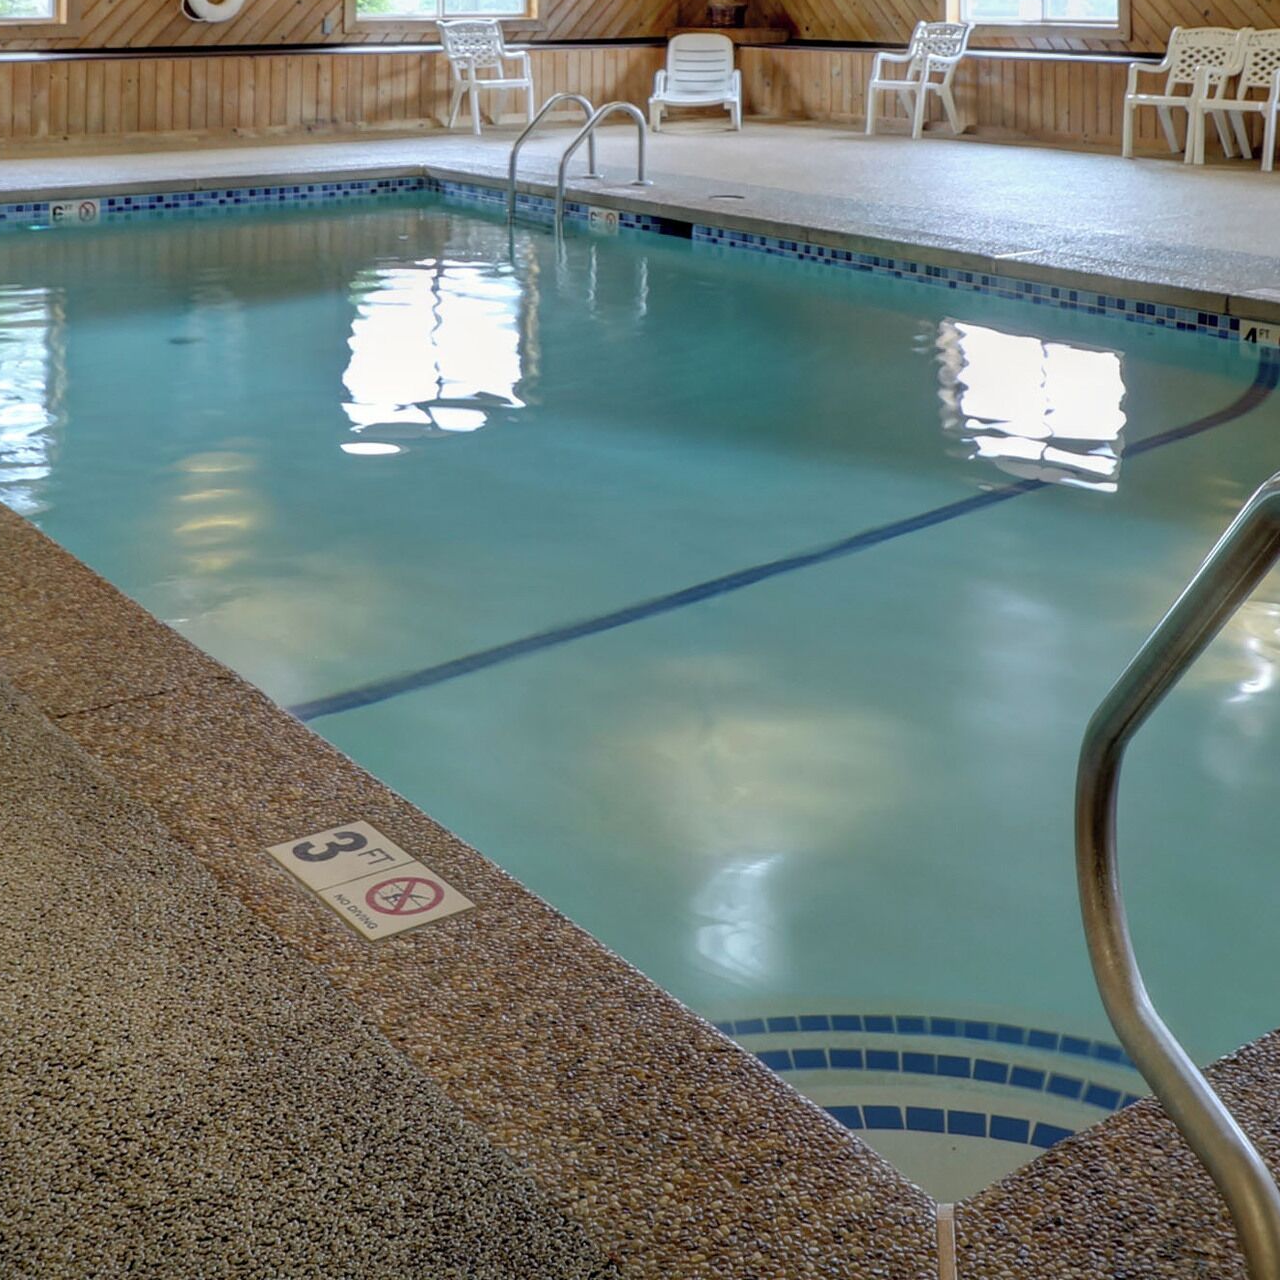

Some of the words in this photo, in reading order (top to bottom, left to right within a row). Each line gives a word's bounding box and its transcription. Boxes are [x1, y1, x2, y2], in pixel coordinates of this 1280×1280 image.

[292, 831, 368, 862] 3
[357, 847, 396, 865] FT
[333, 894, 351, 906] NO
[347, 905, 378, 930] DIVING
